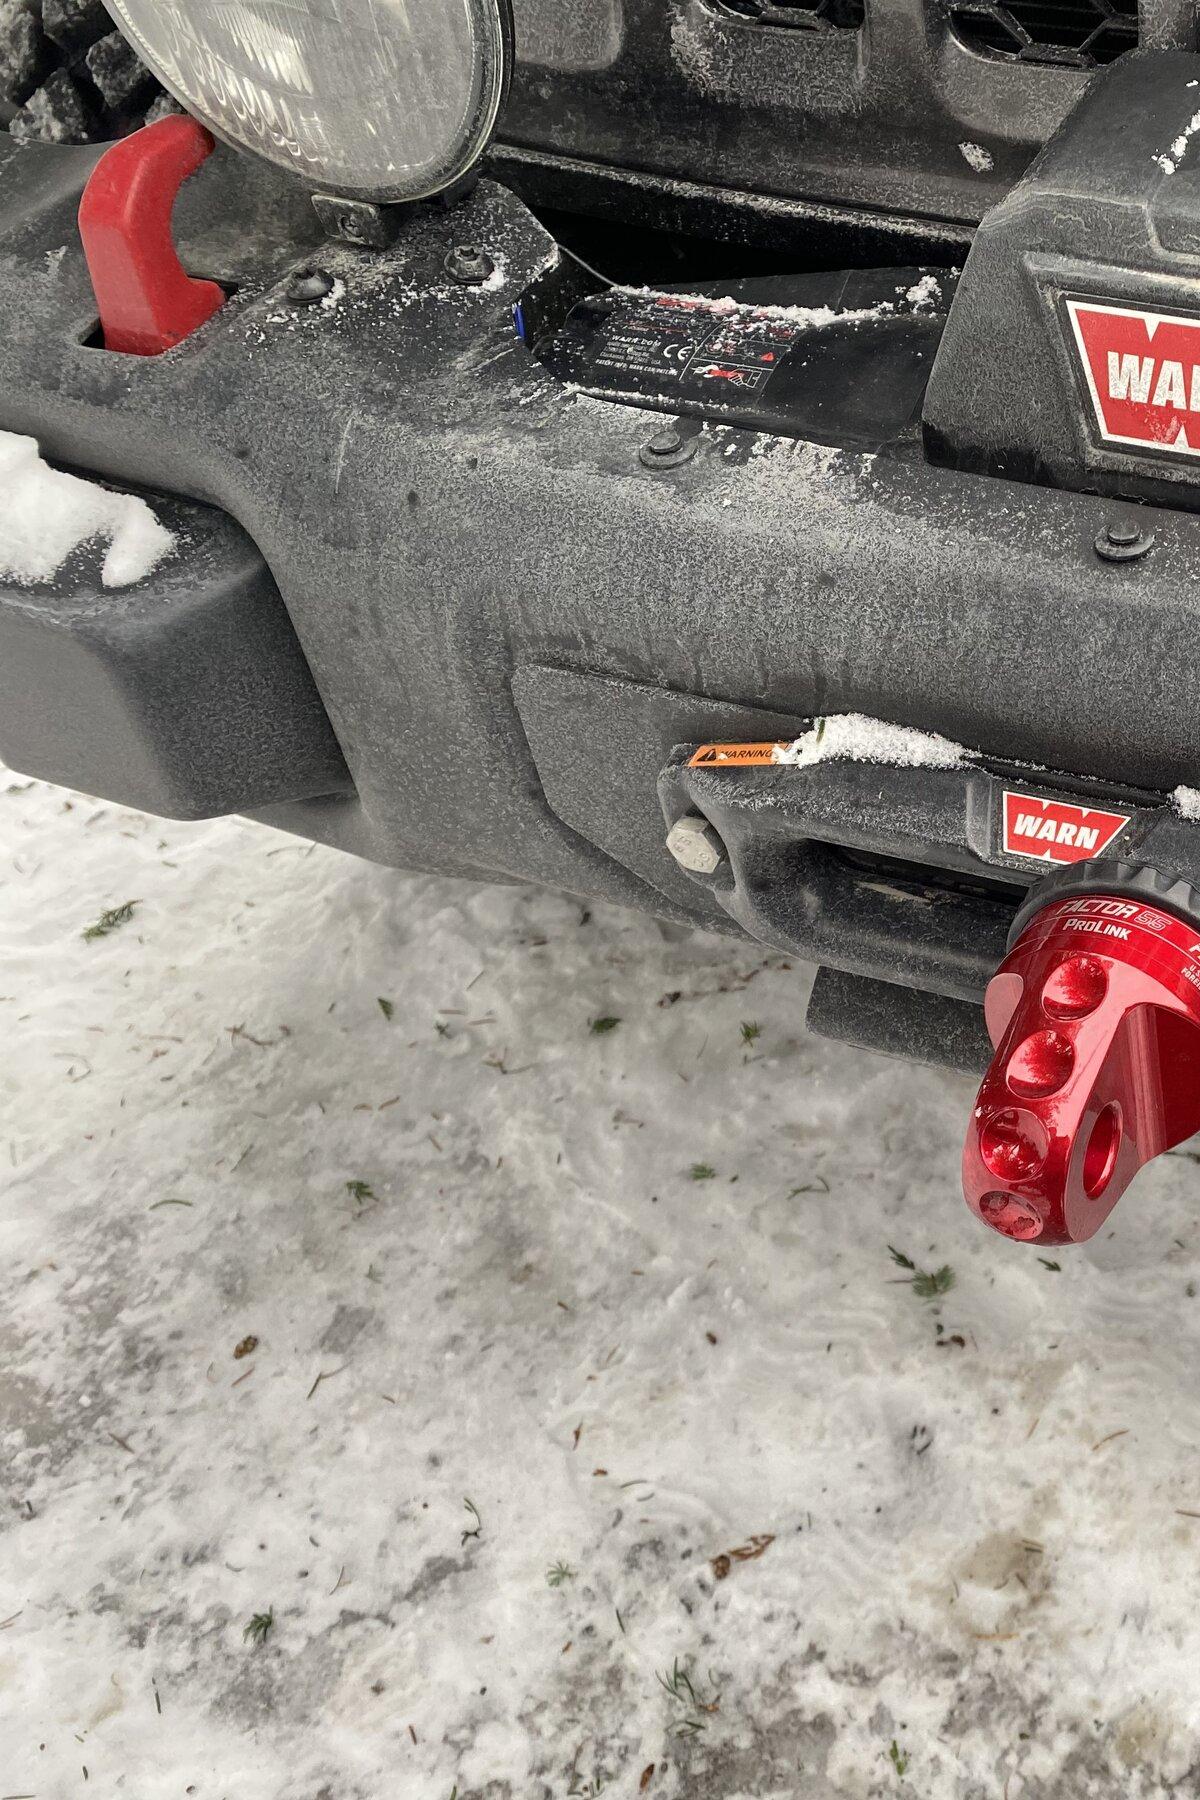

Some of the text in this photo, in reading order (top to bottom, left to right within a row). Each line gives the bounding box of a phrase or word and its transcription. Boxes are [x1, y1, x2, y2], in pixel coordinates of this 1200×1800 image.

[1013, 813, 1100, 850] WARN
[1055, 899, 1173, 931] FACTOR 55
